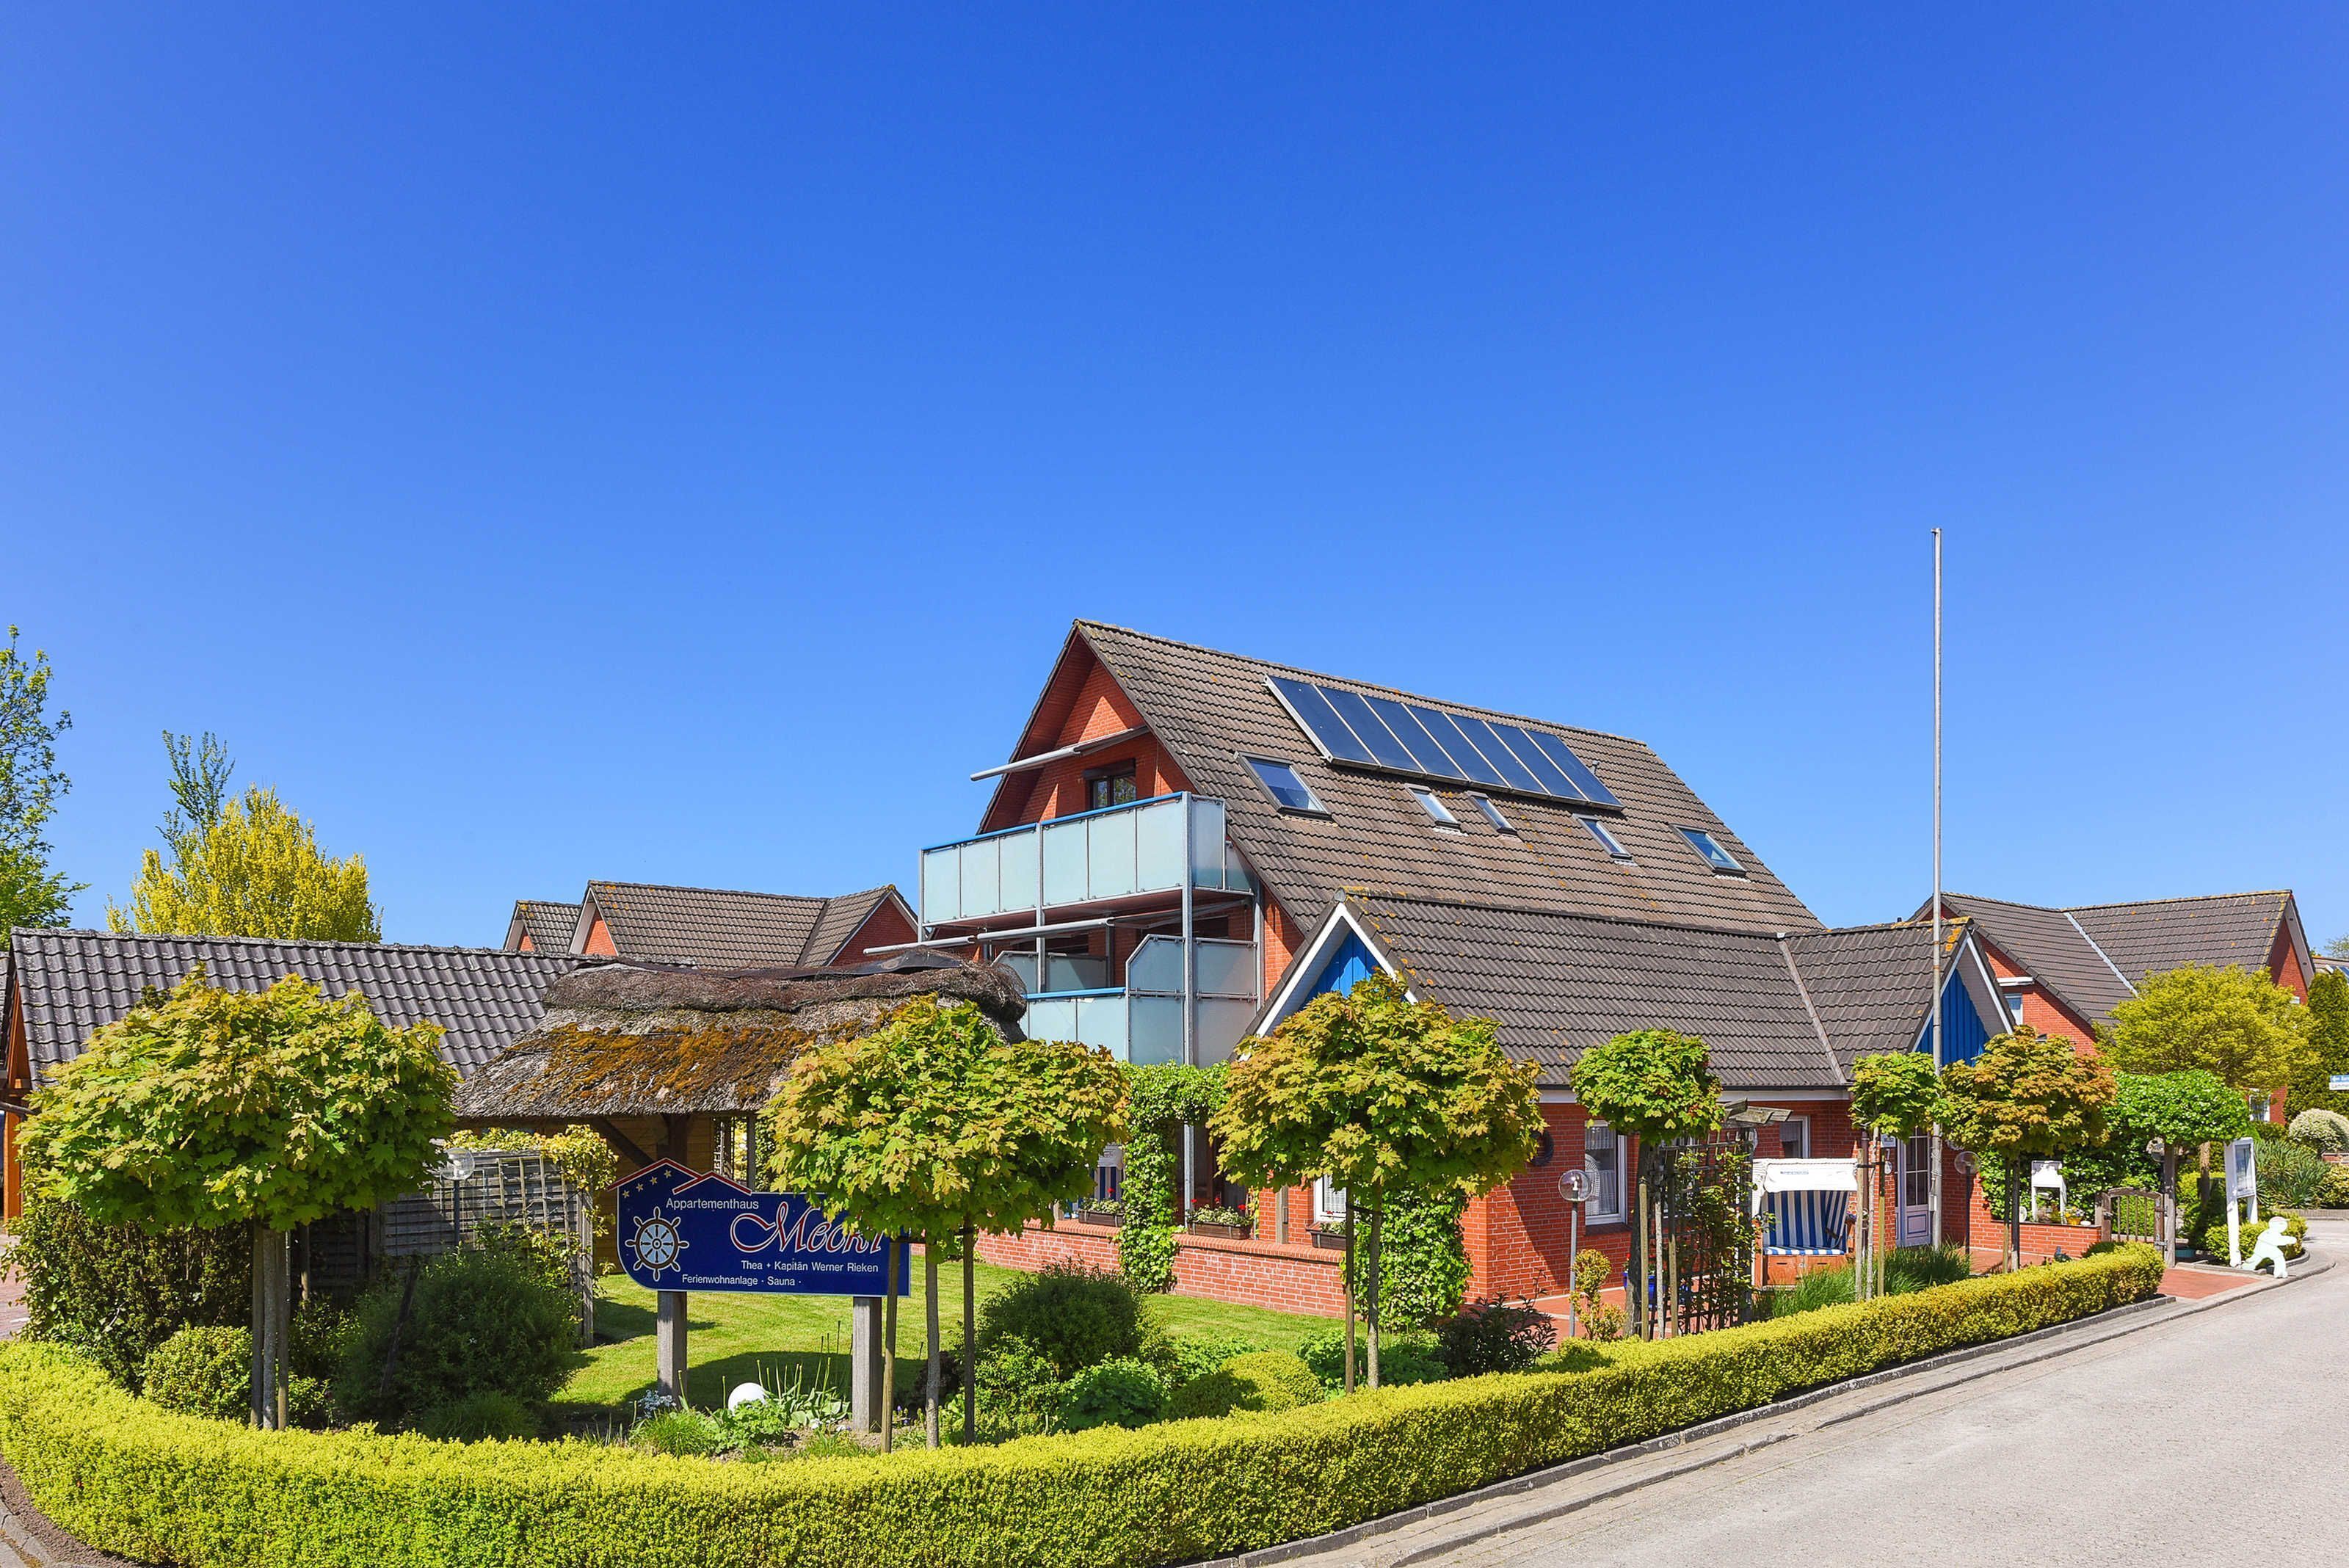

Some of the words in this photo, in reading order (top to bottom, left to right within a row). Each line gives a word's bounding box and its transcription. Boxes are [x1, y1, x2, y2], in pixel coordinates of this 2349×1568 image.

[666, 1197, 759, 1211] Appartementhaus
[741, 1260, 763, 1270] Thea
[774, 1260, 808, 1272] Kapitän
[811, 1262, 844, 1272] Werner
[847, 1262, 879, 1273] Rieken
[682, 1274, 758, 1287] Ferienwohnanlage
[767, 1275, 796, 1286] Sauna
